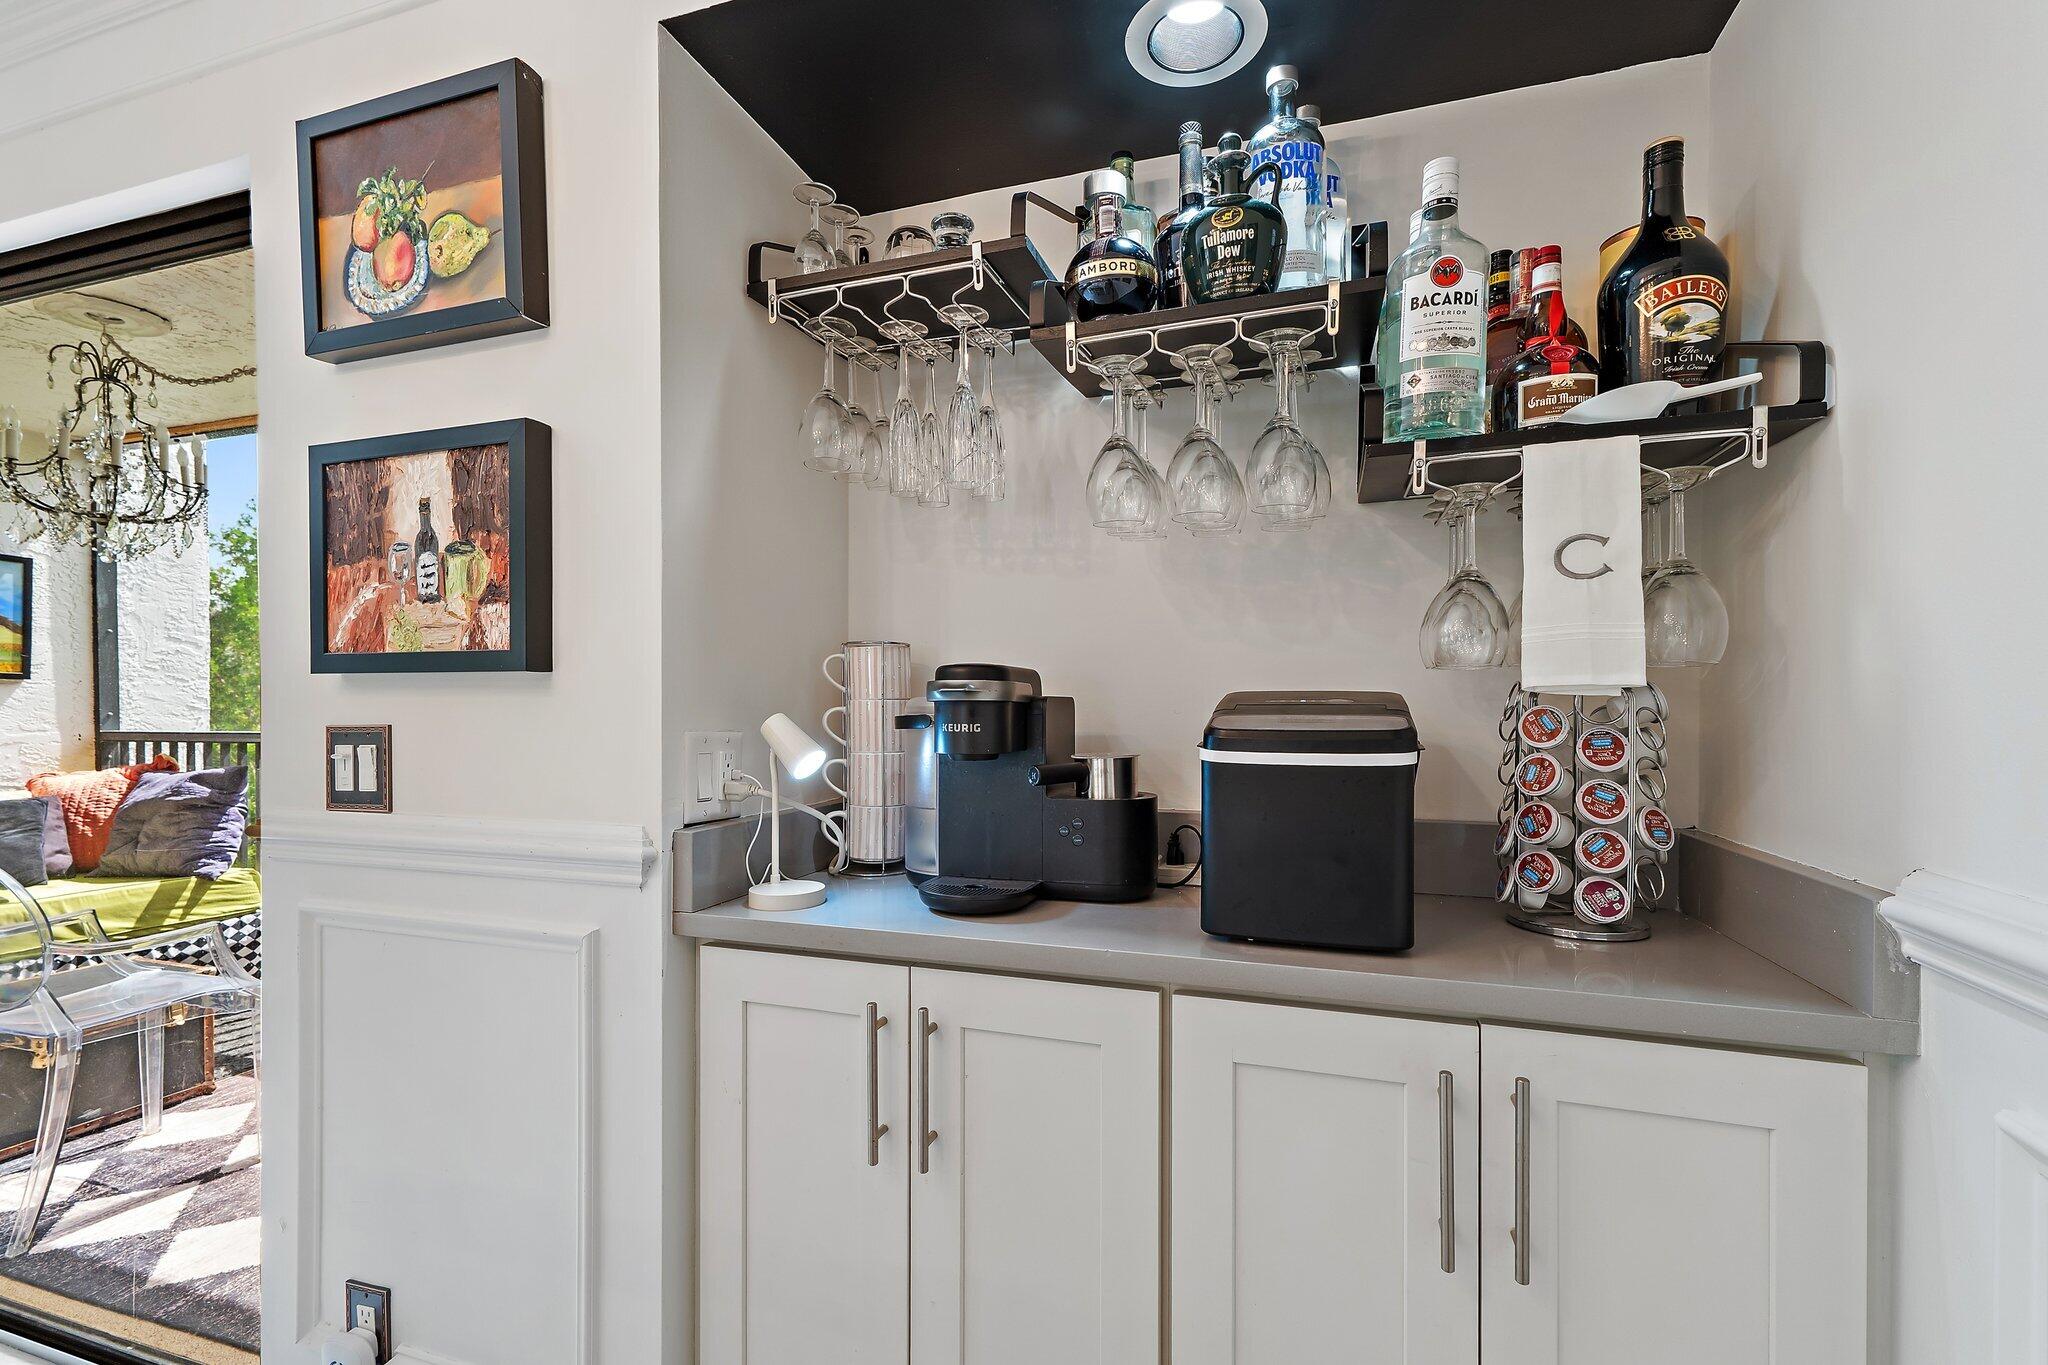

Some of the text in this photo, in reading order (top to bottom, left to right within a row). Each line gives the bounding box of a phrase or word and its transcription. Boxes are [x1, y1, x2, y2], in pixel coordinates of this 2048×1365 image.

[1251, 142, 1322, 172] ABSOLUT
[1258, 161, 1316, 187] VODKA
[1201, 227, 1255, 250] Tullamore
[1217, 244, 1241, 260] Dew
[1075, 260, 1138, 280] AMBORD
[1206, 265, 1256, 280] IRISH WHISKEY
[1410, 289, 1480, 311] BACARDÍ
[1644, 279, 1727, 308] BAILEYS
[1423, 309, 1467, 318] SUPERIOR
[1677, 345, 1700, 355] The
[1651, 354, 1716, 366] ORIGINAL
[1527, 394, 1557, 409] Grand
[1554, 533, 1614, 580] C
[942, 723, 981, 733] KEURIG
